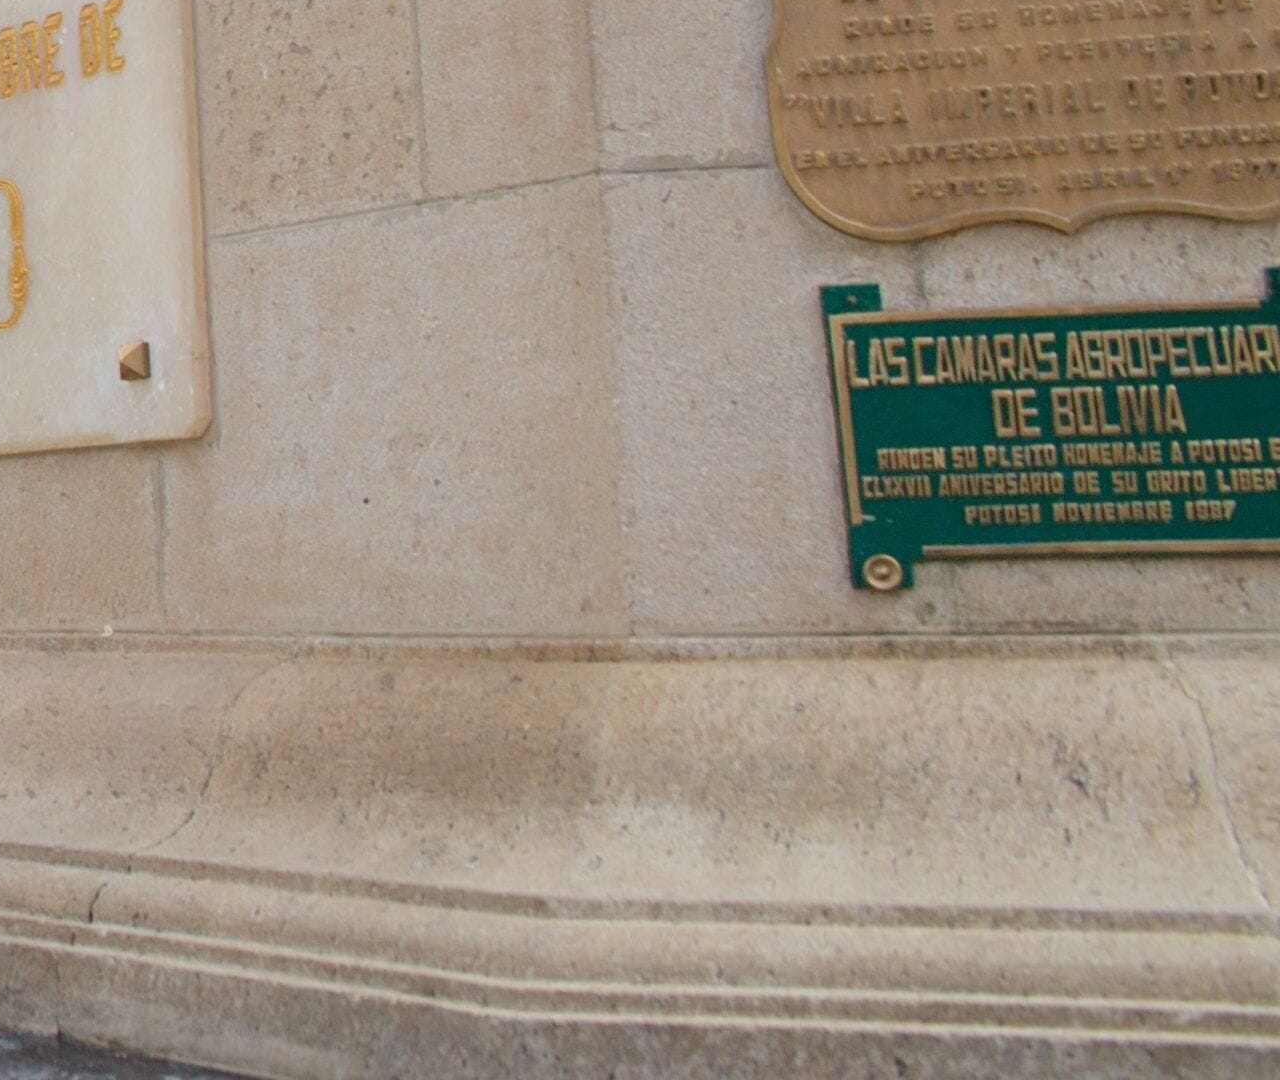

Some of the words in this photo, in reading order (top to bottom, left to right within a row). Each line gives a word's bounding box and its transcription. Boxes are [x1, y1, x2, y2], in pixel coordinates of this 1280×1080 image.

[847, 336, 910, 388] LAS
[913, 332, 1060, 384] CAMARAS
[991, 387, 1042, 438] DE
[1050, 383, 1188, 438] BOLIVIA
[877, 446, 946, 470] RINDEN
[951, 445, 978, 469] SU
[983, 443, 1058, 468] PLEITO
[1062, 441, 1163, 466] HOMENAJE
[1170, 440, 1184, 464] A
[1187, 438, 1263, 464] POTOSI
[939, 471, 1064, 498] ANIVERSARIO
[1073, 470, 1100, 495] DE
[1112, 470, 1138, 495] SU
[1146, 469, 1207, 494] GRITO
[1216, 467, 1280, 494] LIBER
[964, 502, 1041, 526] POTOSI
[1053, 499, 1173, 524] NOVIEMBRE
